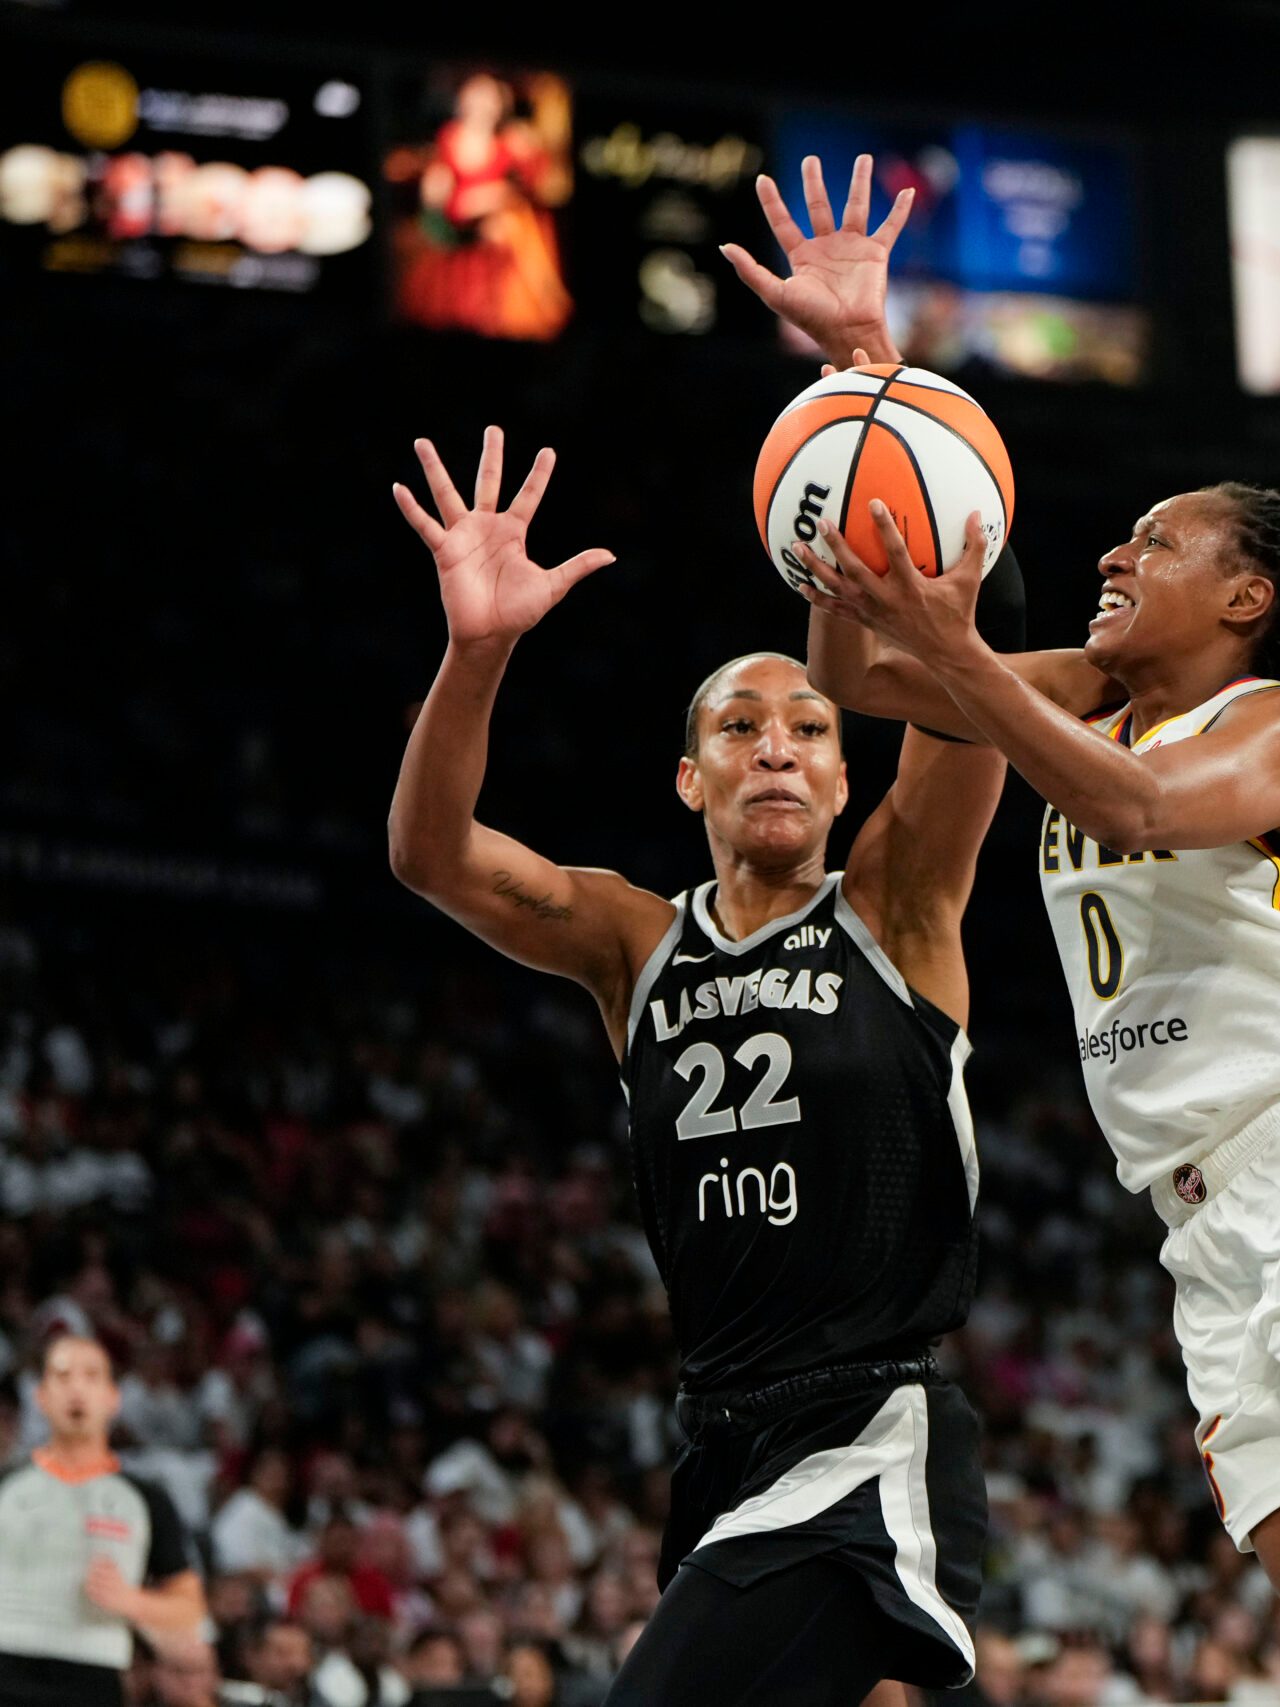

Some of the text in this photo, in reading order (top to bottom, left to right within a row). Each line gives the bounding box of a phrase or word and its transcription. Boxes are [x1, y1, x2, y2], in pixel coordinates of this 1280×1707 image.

[783, 925, 832, 950] ally
[1081, 890, 1123, 1001] 0
[673, 1032, 801, 1140] 22
[699, 1157, 798, 1226] ring
